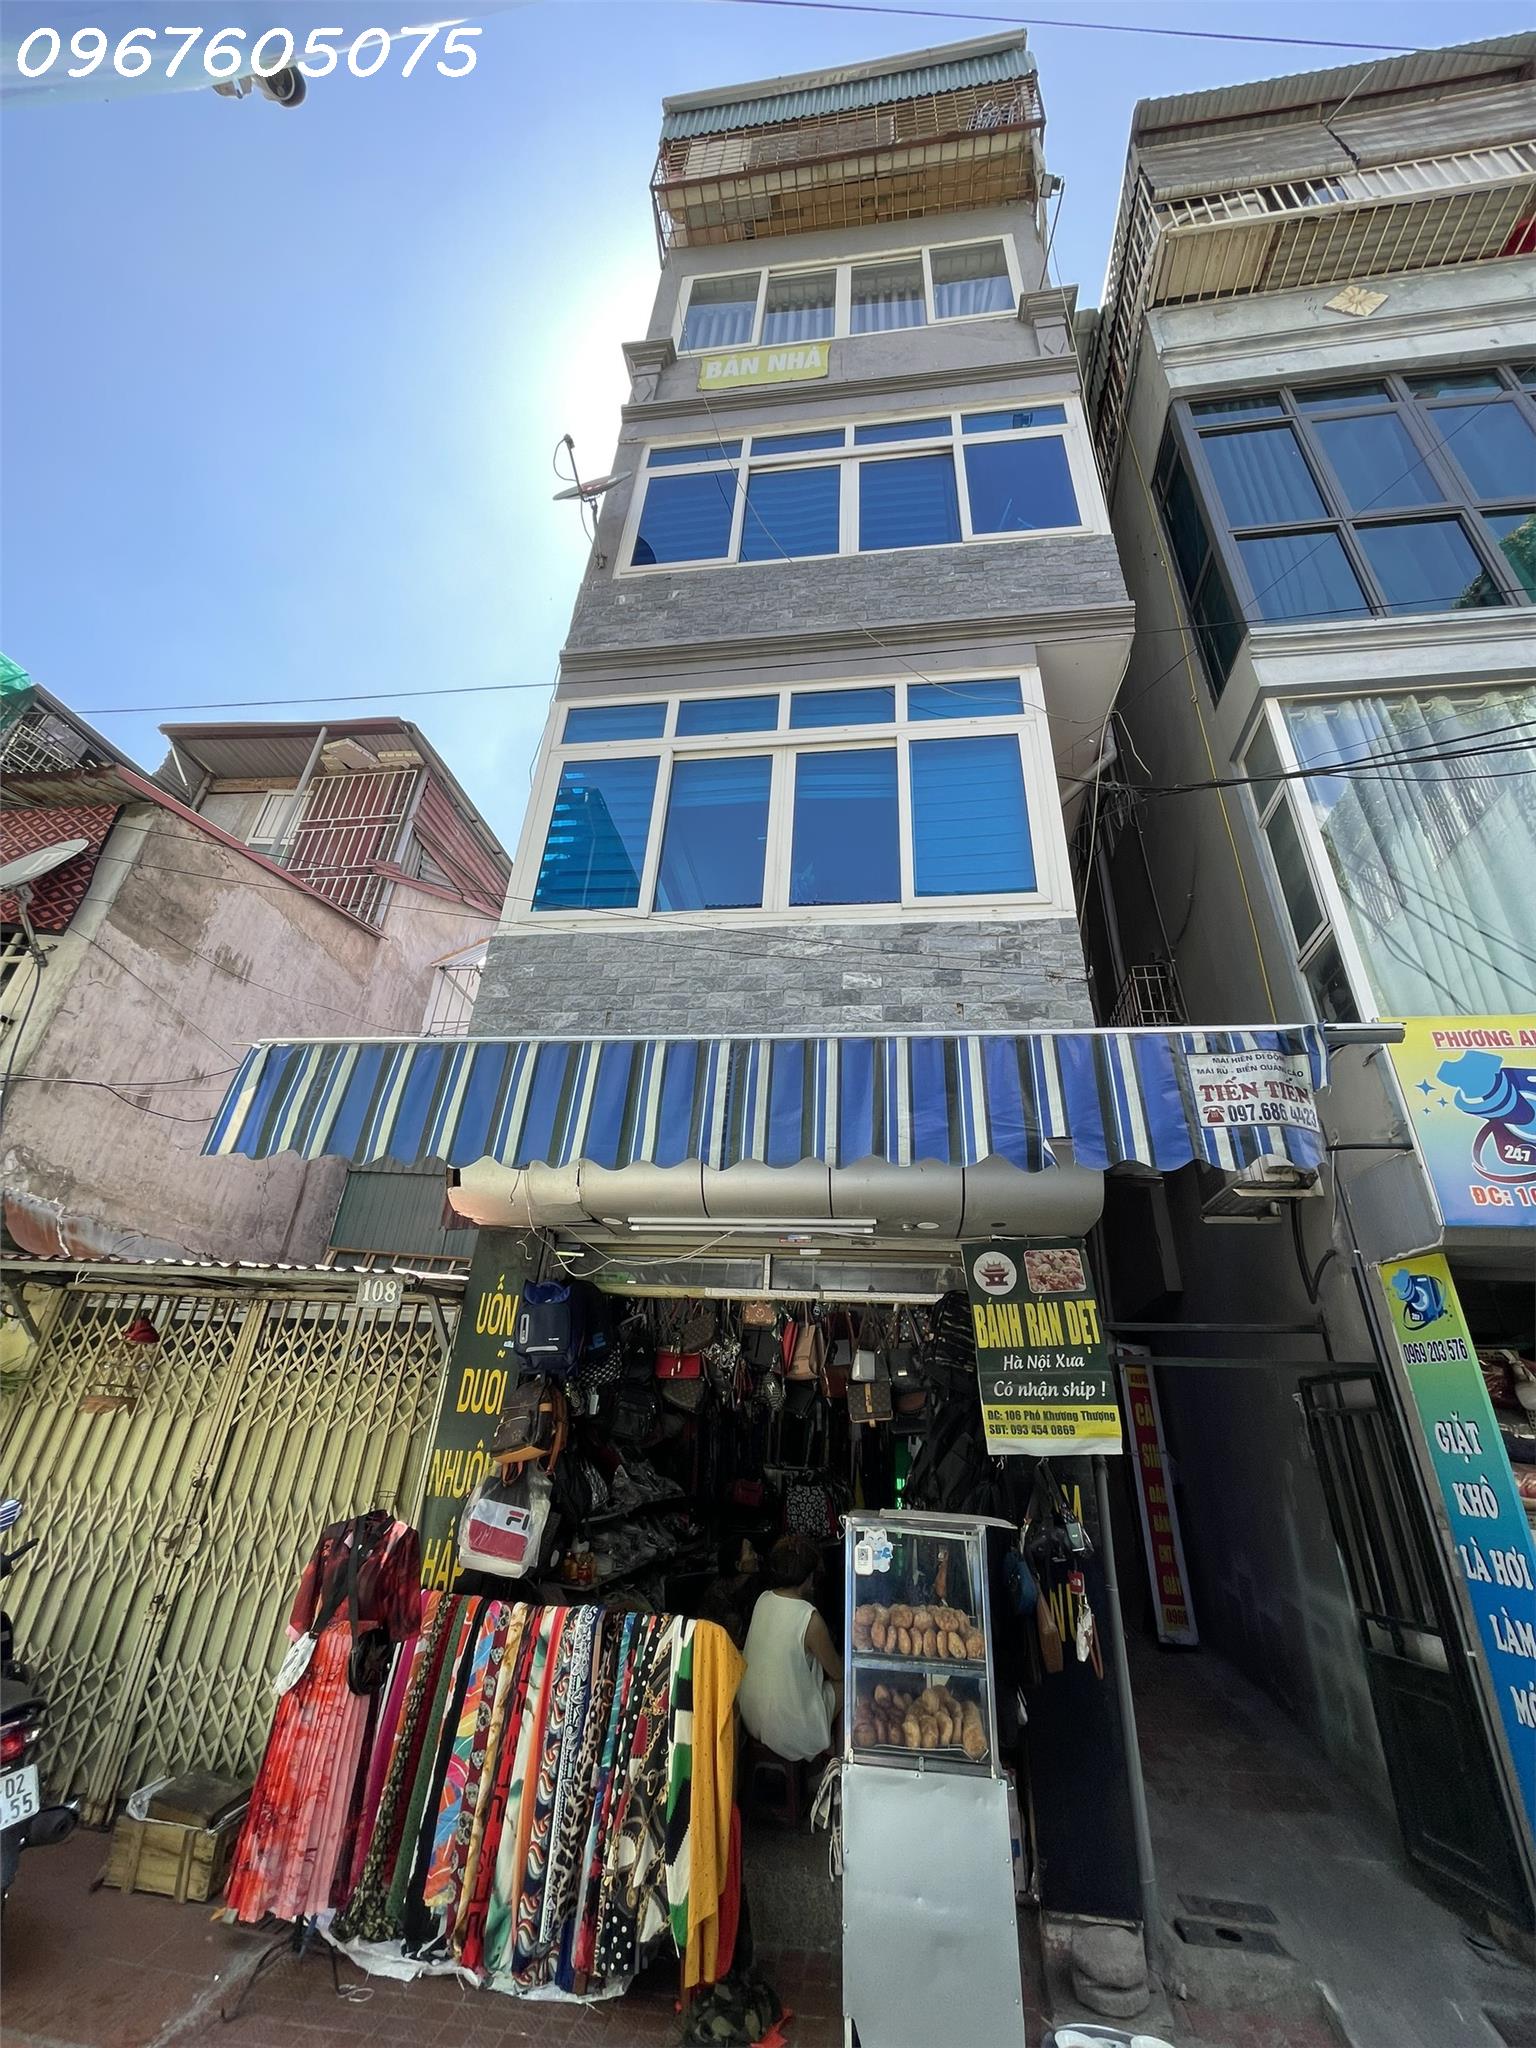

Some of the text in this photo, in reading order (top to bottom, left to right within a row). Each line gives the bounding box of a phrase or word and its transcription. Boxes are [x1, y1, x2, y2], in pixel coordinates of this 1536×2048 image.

[706, 354, 760, 379] BÁN
[1432, 1029, 1514, 1047] PHƯƠNG
[1199, 1076, 1259, 1102] TIẾN
[1504, 1145, 1531, 1163] 247
[1472, 1187, 1511, 1205] ĐC:
[362, 1280, 397, 1303] 108
[476, 1274, 519, 1336] UỐN
[973, 1295, 1101, 1354] BÁNH RÁN DẸT
[1003, 1353, 1085, 1372] Hà Nội Xưa
[1403, 1338, 1469, 1364] 0969 203 576
[993, 1380, 1013, 1397] Có
[1018, 1381, 1060, 1400] nhận
[1062, 1381, 1096, 1400] ship
[987, 1410, 1003, 1421] ĐC:
[1005, 1410, 1022, 1421] 106
[1043, 1410, 1079, 1422] Khương
[1080, 1410, 1116, 1423] Thượng
[1010, 1424, 1029, 1435] 093
[1031, 1424, 1049, 1435] 454
[1051, 1424, 1076, 1435] 0869
[1435, 1411, 1483, 1462] GIẶT
[1453, 1475, 1499, 1519] KHÔ
[1459, 1536, 1534, 1590] LÀ HƠI
